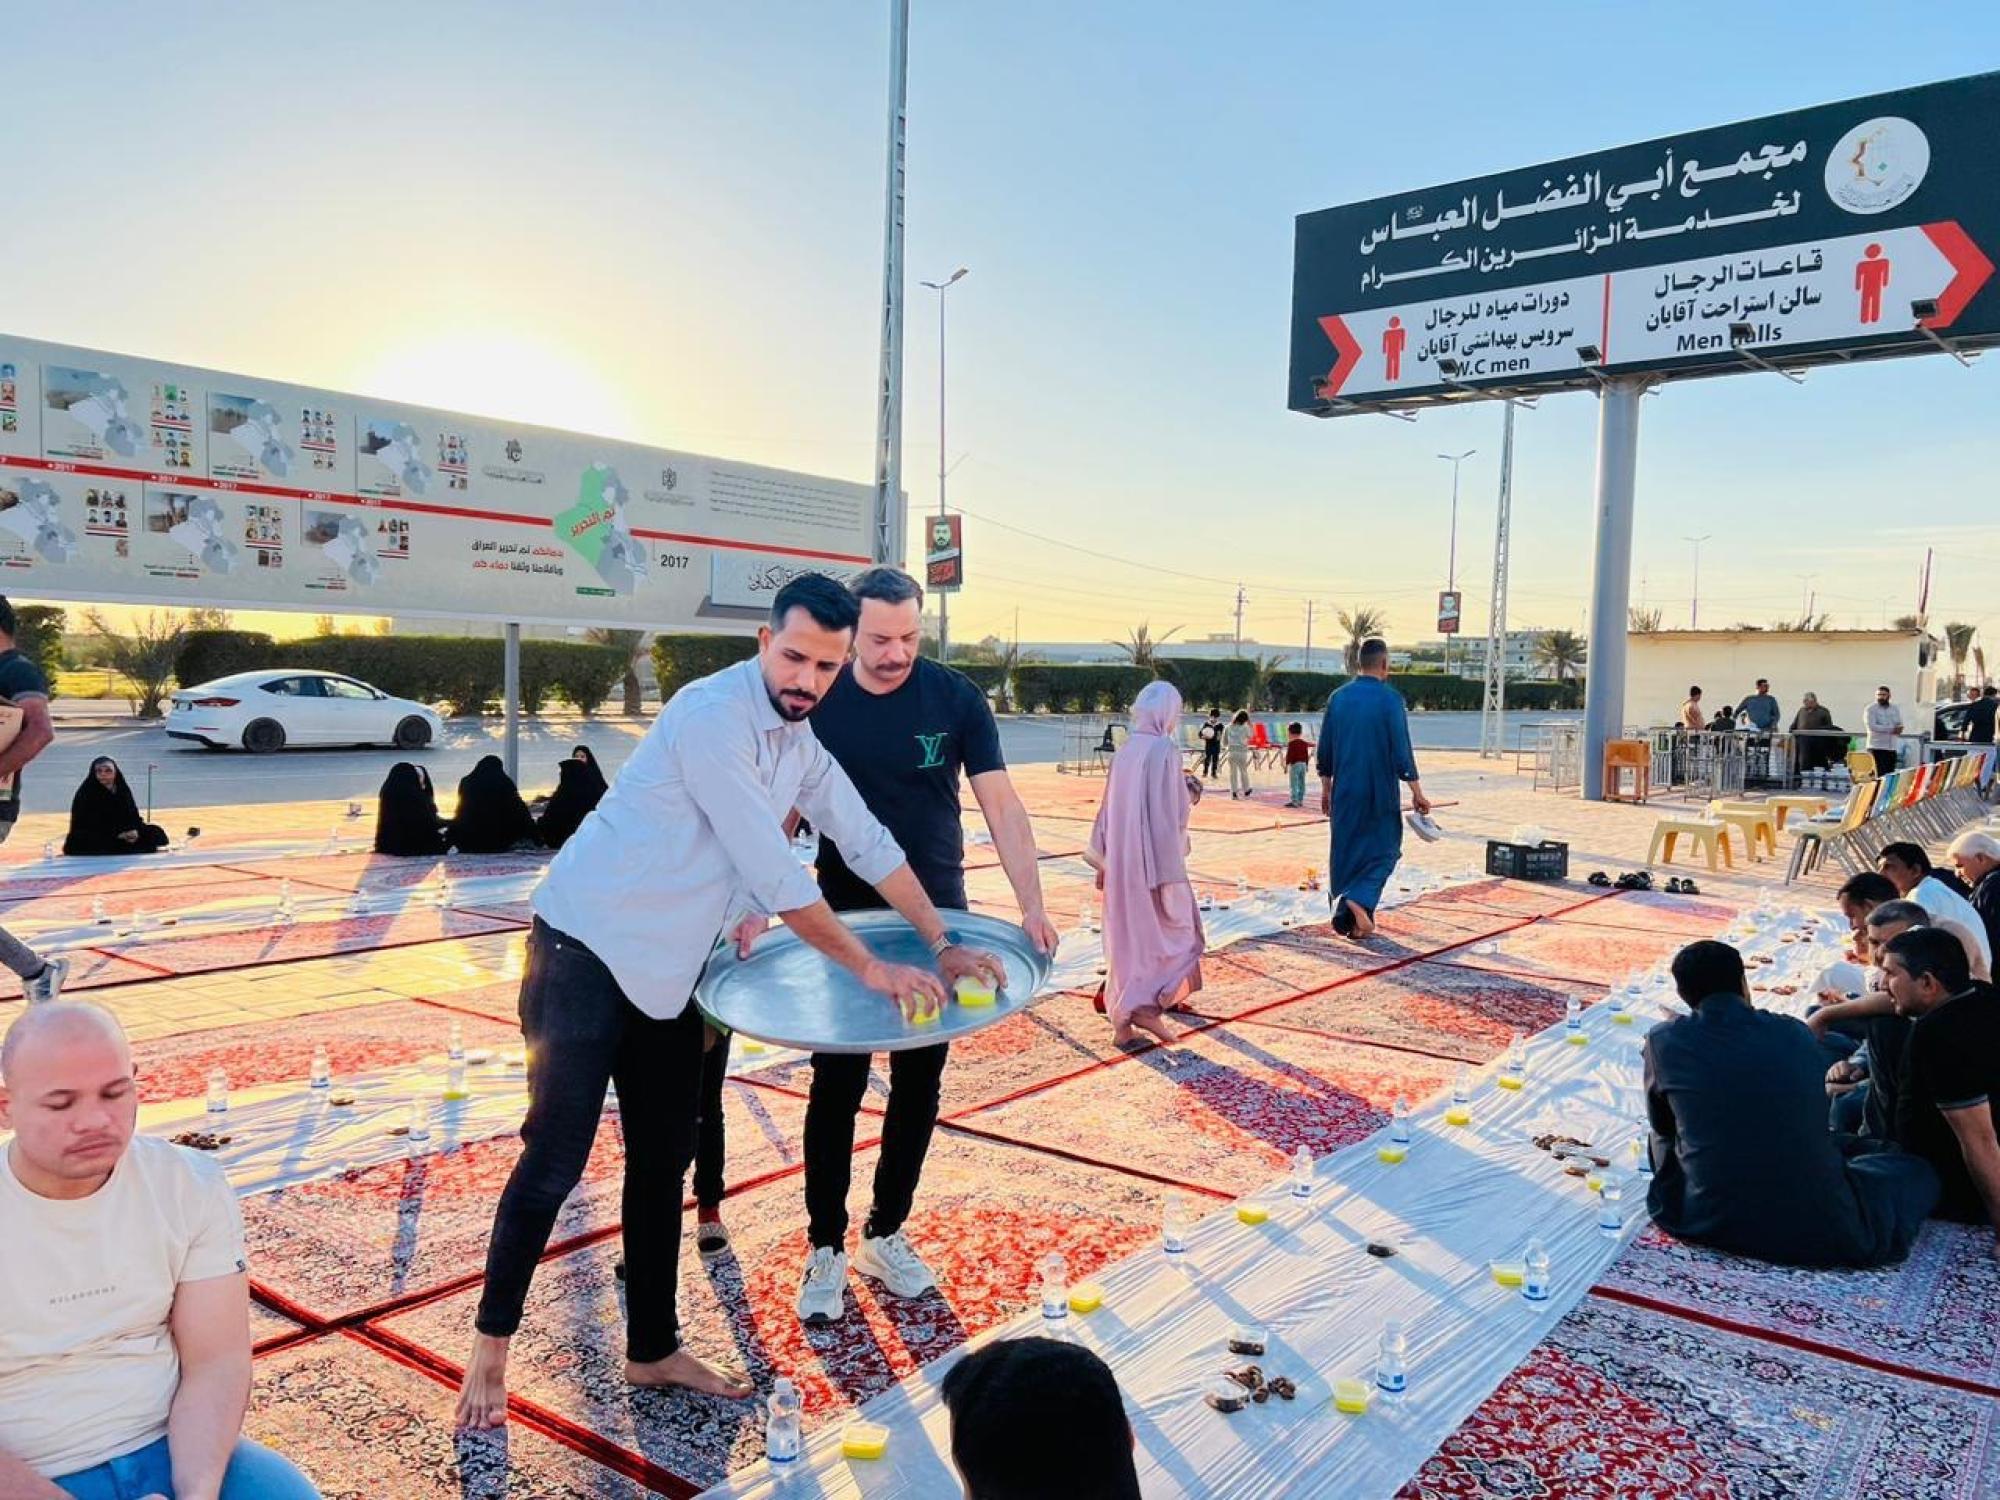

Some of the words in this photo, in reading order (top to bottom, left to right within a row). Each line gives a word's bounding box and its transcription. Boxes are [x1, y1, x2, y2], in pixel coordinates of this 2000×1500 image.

[1604, 146, 1674, 214] أبي
[1679, 139, 1808, 198] مجمع
[1481, 167, 1602, 231] الفضل
[1623, 190, 1802, 242] لخدمة
[1480, 221, 1623, 273] الزائرين
[1361, 246, 1479, 294] الكرام
[1654, 263, 1735, 299] الرجال
[1736, 248, 1824, 282] قاعات
[1424, 301, 1482, 331] للرجال
[1485, 298, 1519, 321] مياه
[1521, 291, 1570, 315] دورات
[1701, 289, 1776, 321] استراحت
[1778, 285, 1823, 315] سالن
[1676, 332, 1724, 352] Men
[1490, 357, 1531, 374] men
[660, 554, 689, 569] 2017
